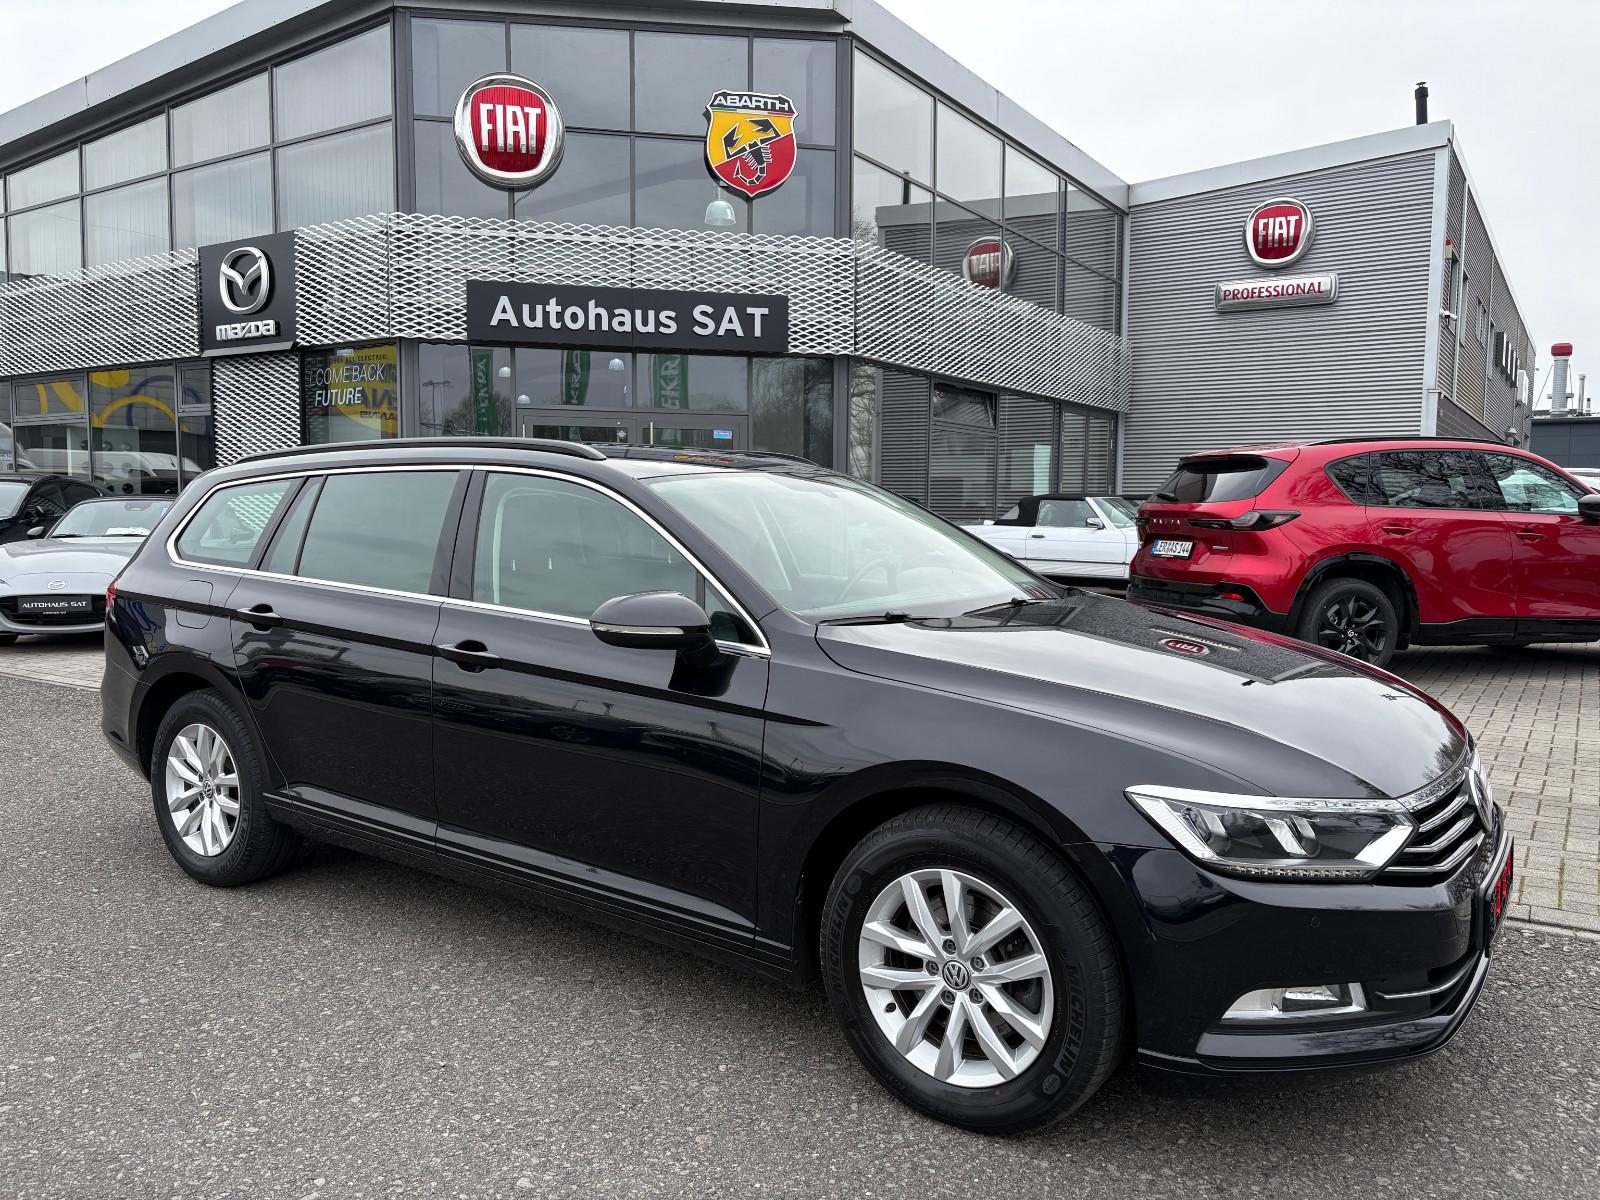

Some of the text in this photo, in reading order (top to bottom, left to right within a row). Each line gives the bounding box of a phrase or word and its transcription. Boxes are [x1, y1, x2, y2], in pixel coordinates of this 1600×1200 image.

[713, 95, 789, 111] ABARTH
[480, 103, 541, 154] FIAT
[1258, 215, 1299, 249] FIAT
[1223, 281, 1325, 301] PROFESSIONAL
[490, 295, 769, 337] Autohaus SAT
[314, 386, 362, 407] FUTURE
